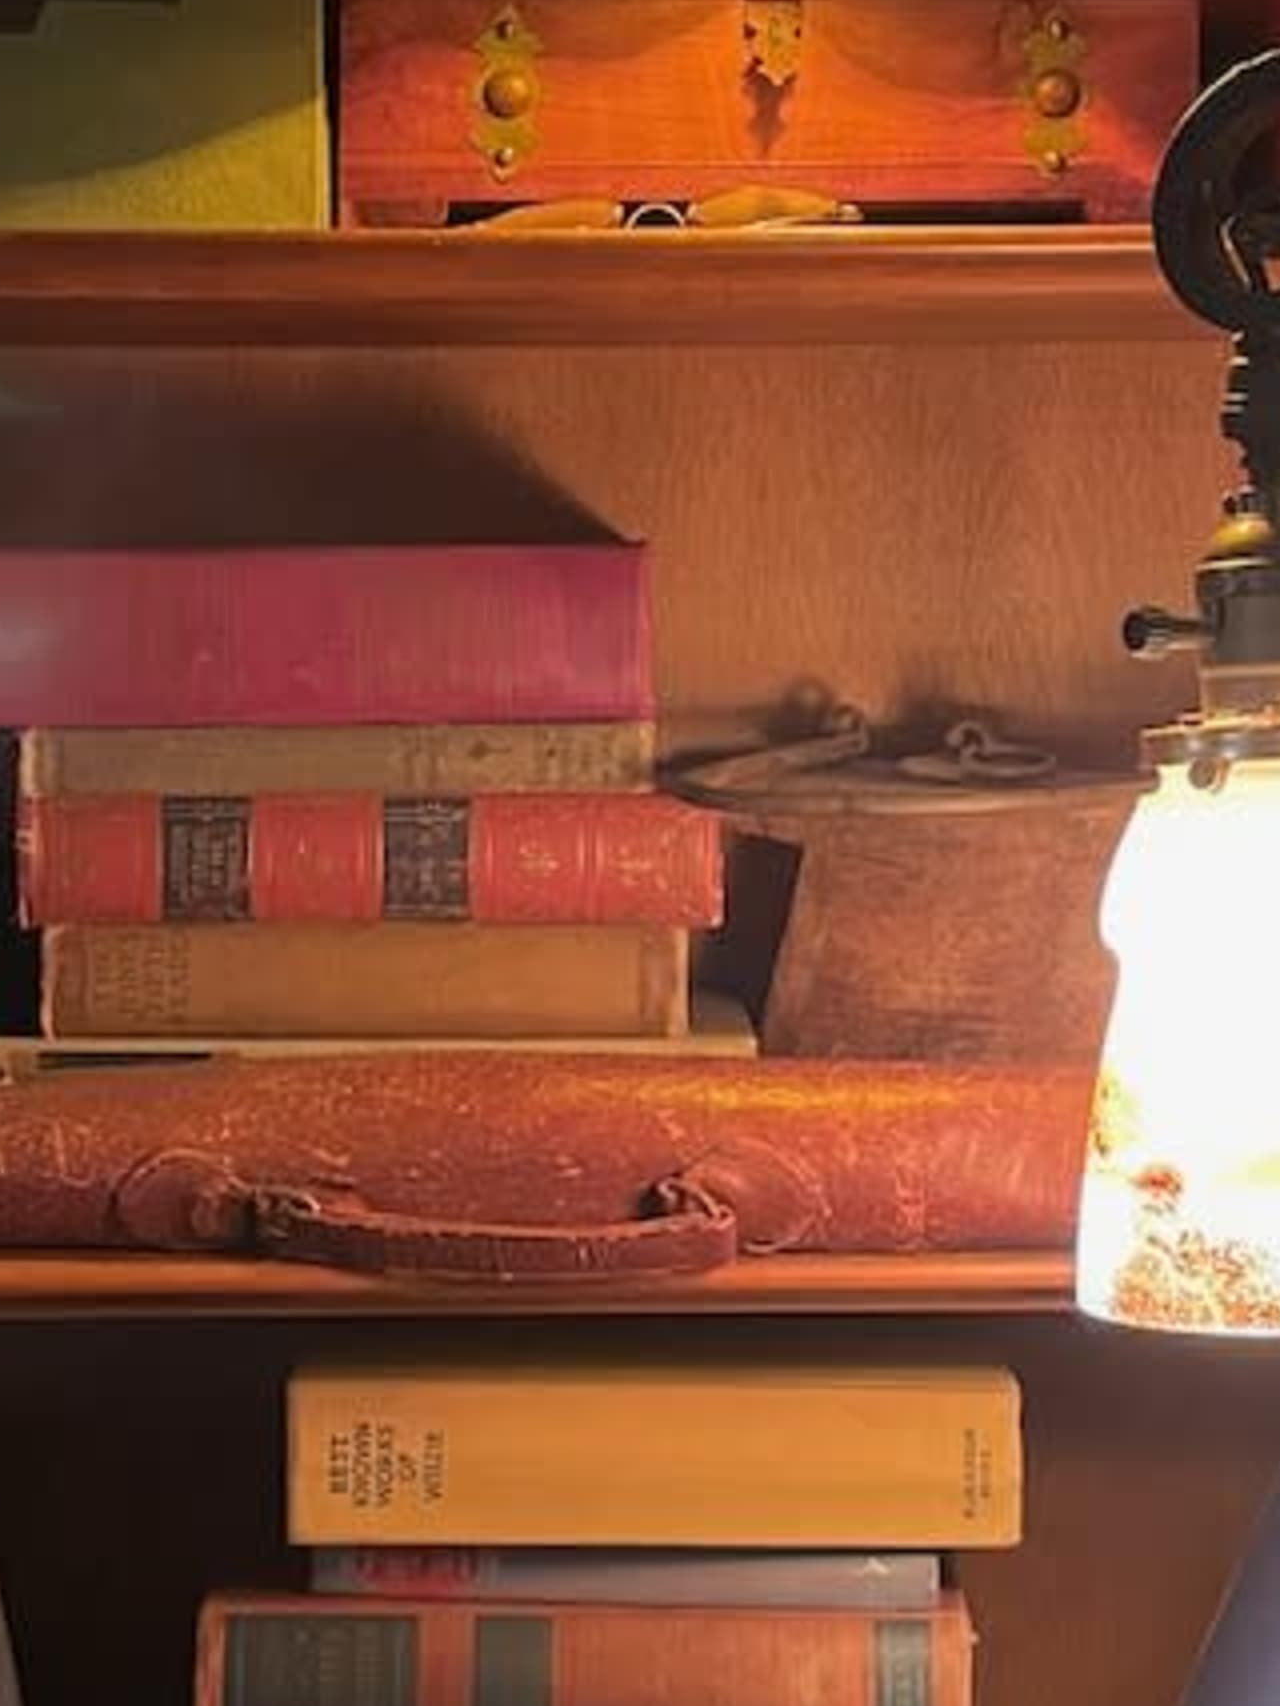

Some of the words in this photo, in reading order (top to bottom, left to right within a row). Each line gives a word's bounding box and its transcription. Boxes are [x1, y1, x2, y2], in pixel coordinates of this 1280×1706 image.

[330, 1436, 349, 1493] BEST
[351, 1422, 371, 1506] KNOWN
[377, 1426, 395, 1505] WORKS
[398, 1453, 418, 1481] OF
